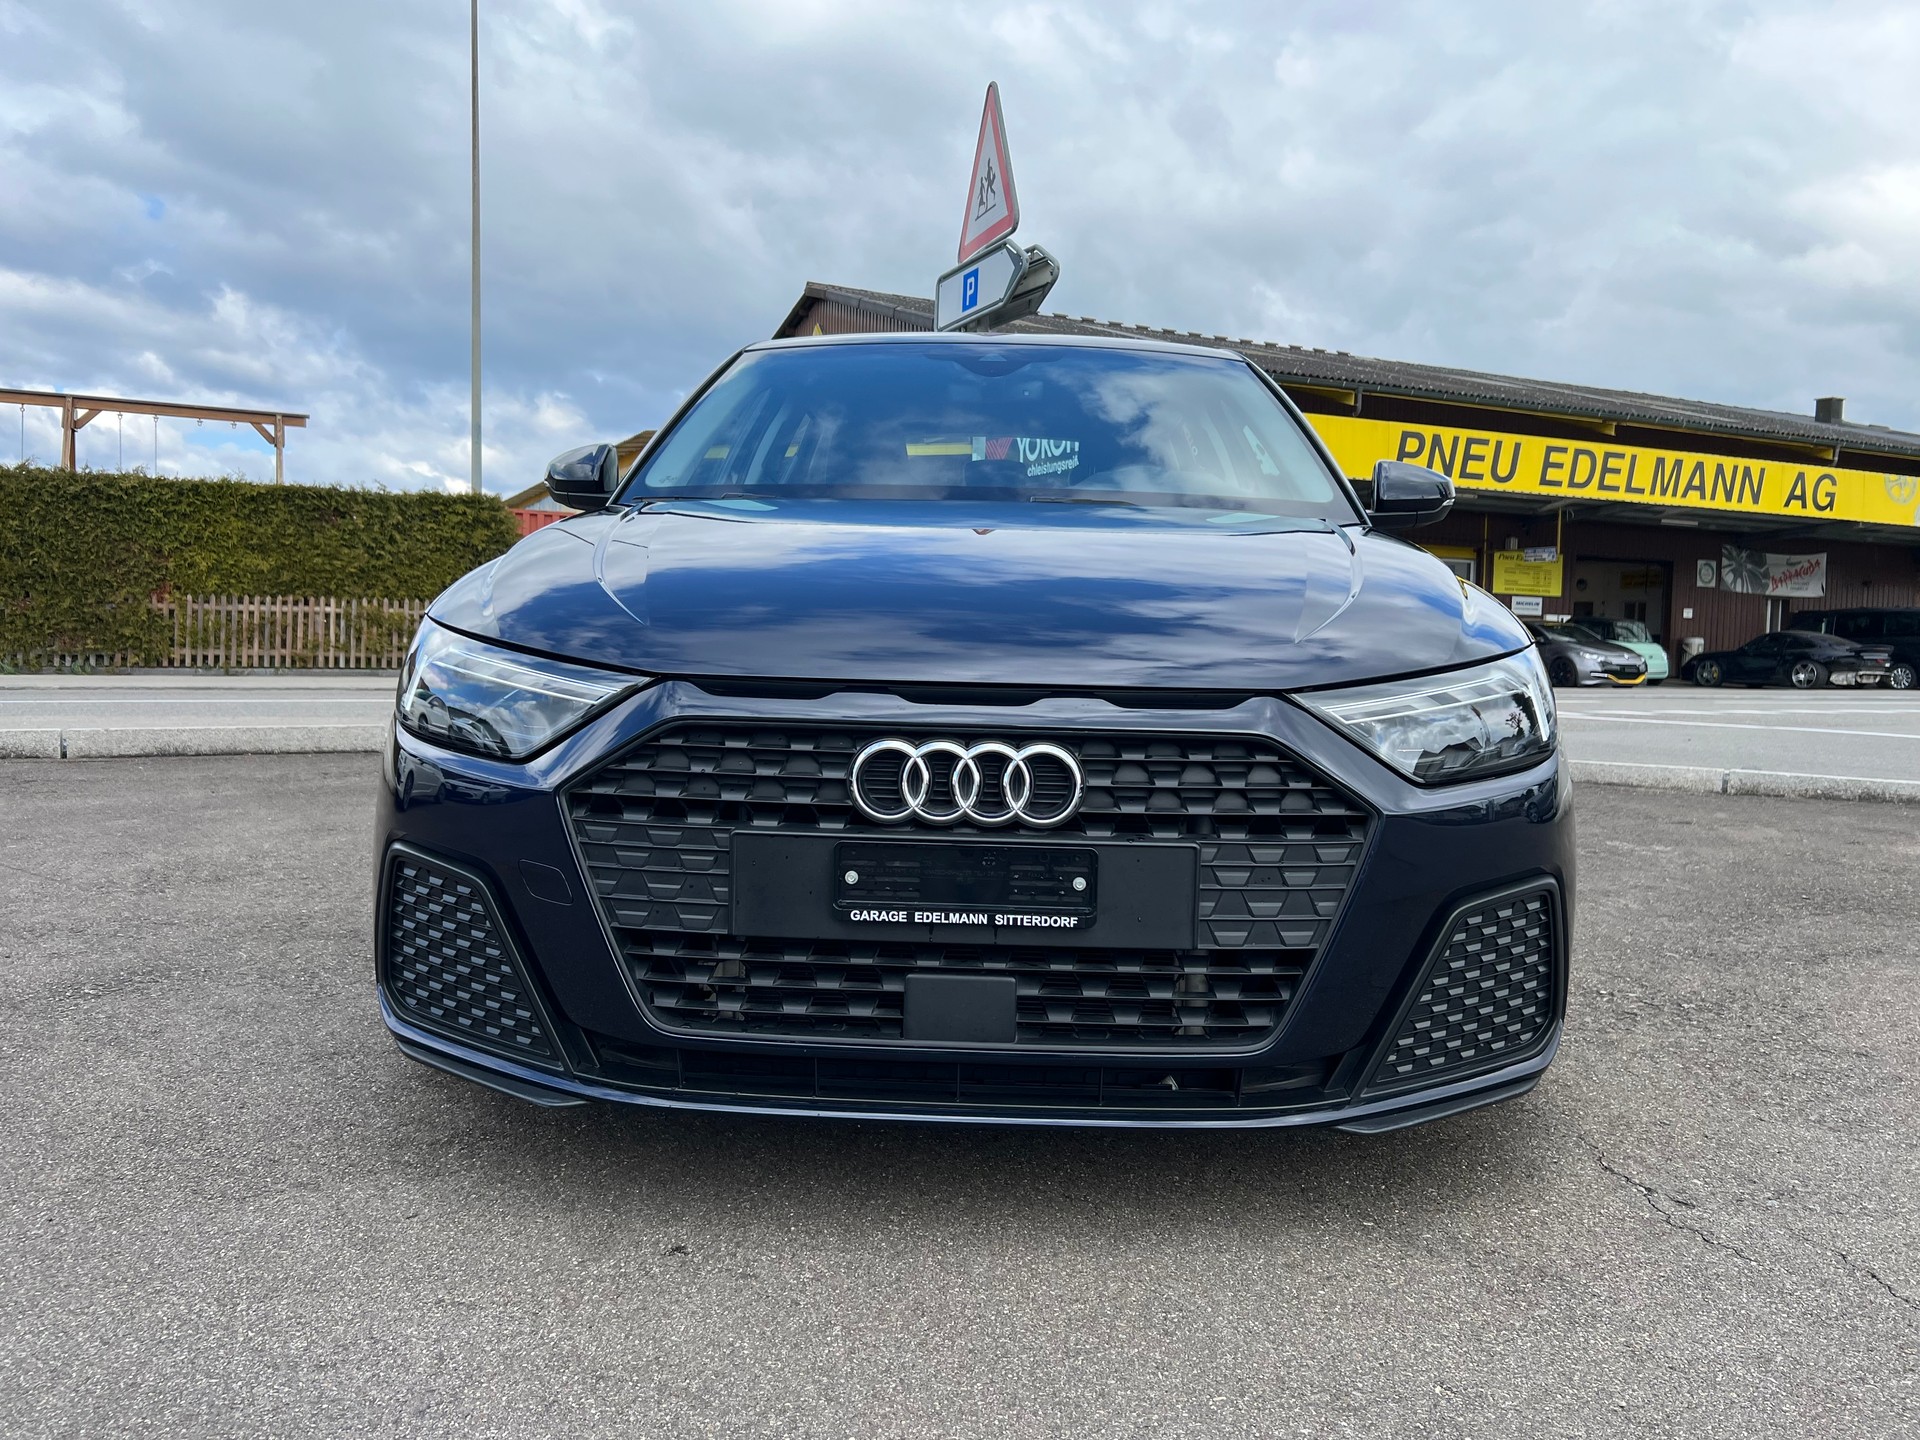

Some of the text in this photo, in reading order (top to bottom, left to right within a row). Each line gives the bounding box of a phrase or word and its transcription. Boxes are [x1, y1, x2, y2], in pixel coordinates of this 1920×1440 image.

[966, 276, 975, 306] P
[1396, 430, 1838, 512] PNEU EDELMANN AG
[850, 910, 1079, 928] GARAGE EDELMANN SITTERDORF
